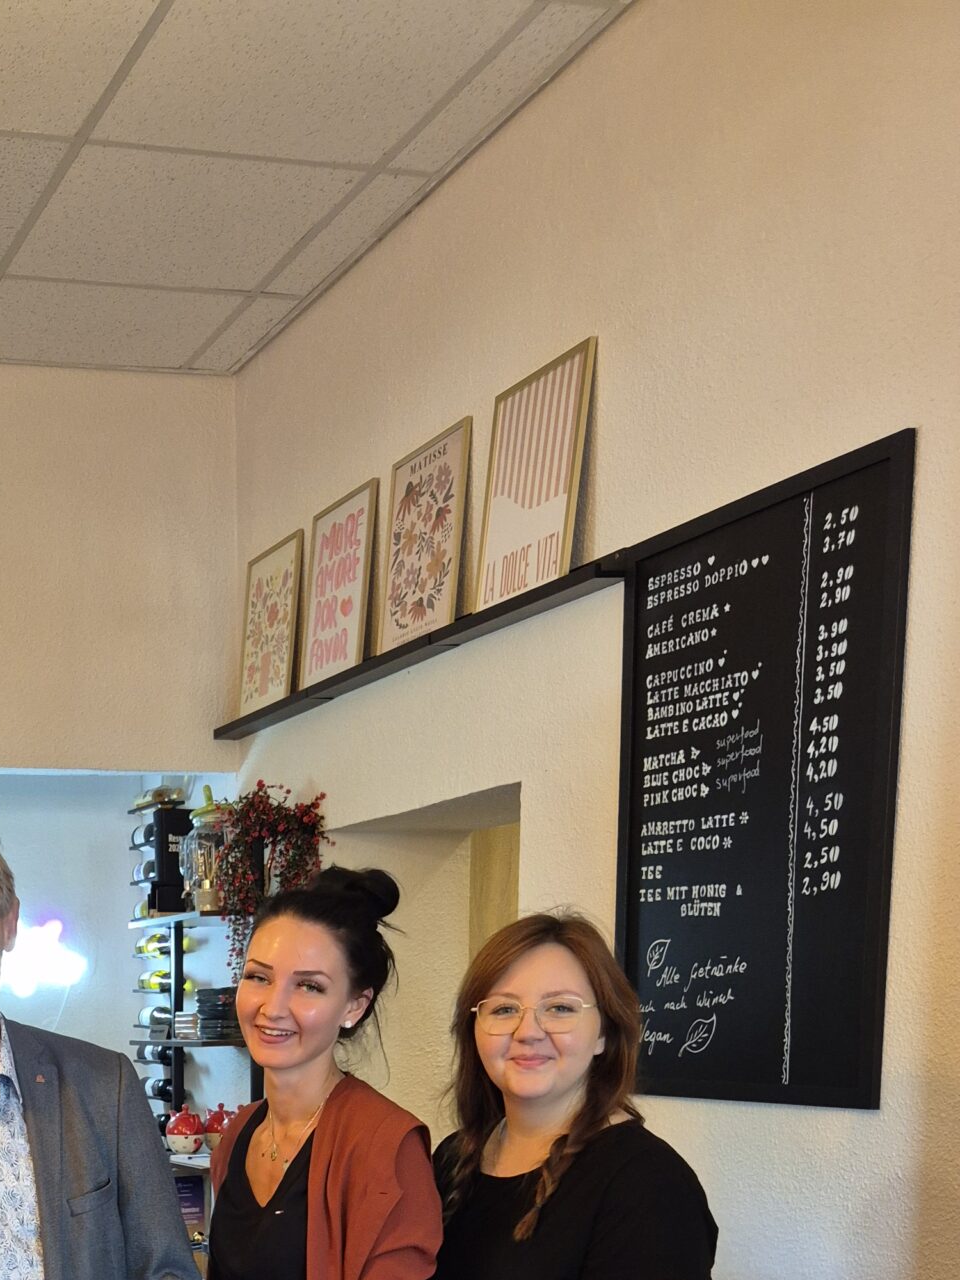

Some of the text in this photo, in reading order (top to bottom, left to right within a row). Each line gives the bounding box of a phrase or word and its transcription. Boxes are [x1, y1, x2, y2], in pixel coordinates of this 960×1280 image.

[410, 442, 448, 477] MATISSE
[318, 507, 365, 568] MORE
[823, 529, 855, 553] 3,70
[315, 548, 360, 599] AMORE
[483, 531, 559, 605] LA DOLCE VITA
[648, 562, 701, 591] ESPRESSO
[820, 564, 854, 588] 2,90
[646, 559, 748, 610] ESPRESSO DOPPIO
[820, 584, 851, 609] 2,90
[312, 595, 338, 637] POR
[647, 603, 720, 639] CAFÉ CREMA
[818, 617, 848, 641] 3,90
[308, 628, 348, 676] FAVOR
[645, 628, 709, 659] AMERICANO
[816, 638, 848, 662] 3,90
[646, 658, 714, 689] CAPPUCCINO
[816, 659, 846, 682] 3,50
[647, 671, 749, 706] LATTE MACCHIATO
[814, 681, 843, 705] 3,50
[647, 691, 730, 721] BAMBINO LATTE
[645, 710, 728, 740] LATTE E CACAO
[716, 718, 761, 751] superfood
[809, 714, 839, 735] 4,50
[643, 734, 763, 772] MATCHA superfood
[807, 736, 839, 759] 4,20
[643, 759, 760, 794] BLUE CHOC superfood
[806, 758, 838, 783] 4,20
[643, 784, 698, 807] PINK CHOC
[806, 793, 844, 817] 4,50
[640, 812, 736, 837] AMARETTO LATTE
[803, 818, 838, 841] 4,50
[641, 834, 720, 856] LATTE E COCO
[803, 845, 840, 869] 2,50
[641, 865, 663, 880] TEE
[801, 870, 841, 896] 2,90
[639, 888, 662, 902] TEE
[667, 886, 688, 901] MIT
[691, 884, 727, 899] HONIG
[680, 899, 722, 917] BLÜTEN
[656, 966, 680, 987] Alle
[664, 995, 688, 1011] nach
